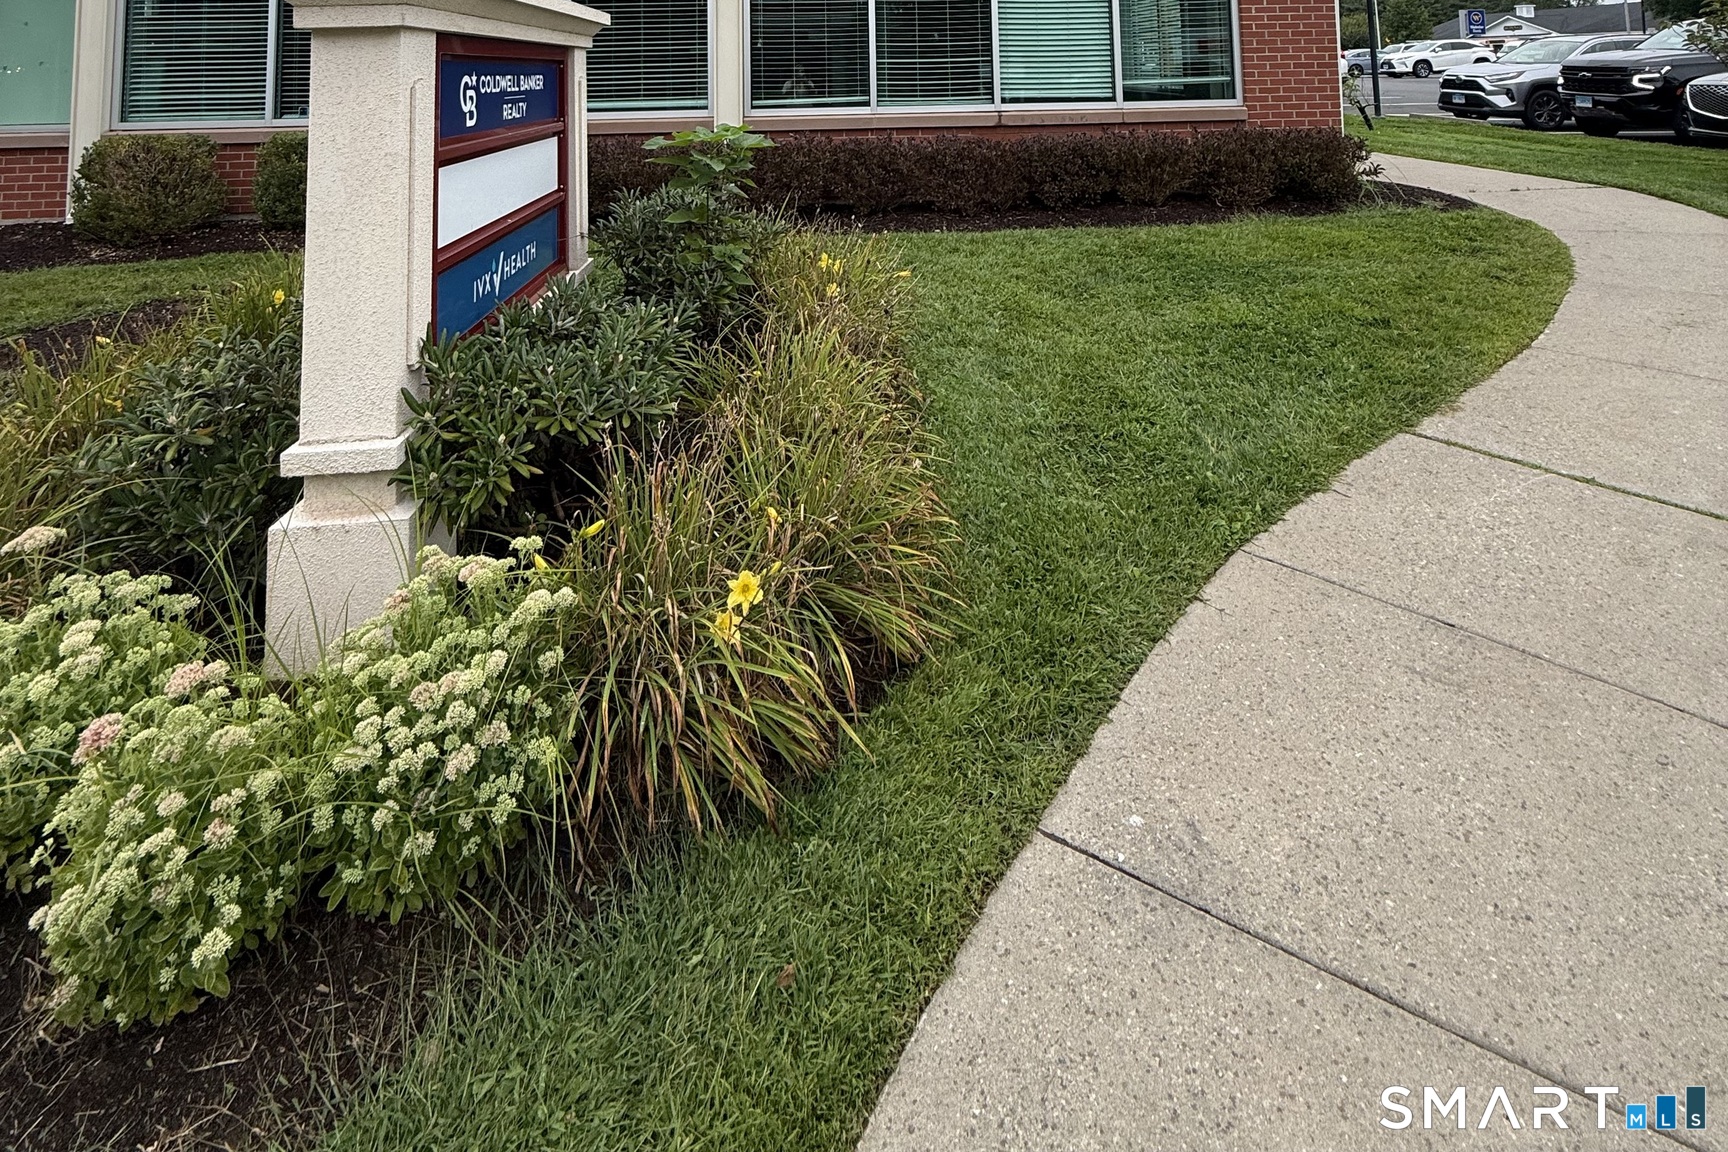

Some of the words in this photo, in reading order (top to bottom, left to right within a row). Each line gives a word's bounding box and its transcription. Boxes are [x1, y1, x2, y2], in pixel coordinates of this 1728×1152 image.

[480, 75, 519, 93] COLDWELL
[520, 74, 544, 91] BANKER
[503, 102, 527, 120] REALTY
[473, 271, 491, 303] IVX
[503, 240, 536, 281] HEALTH
